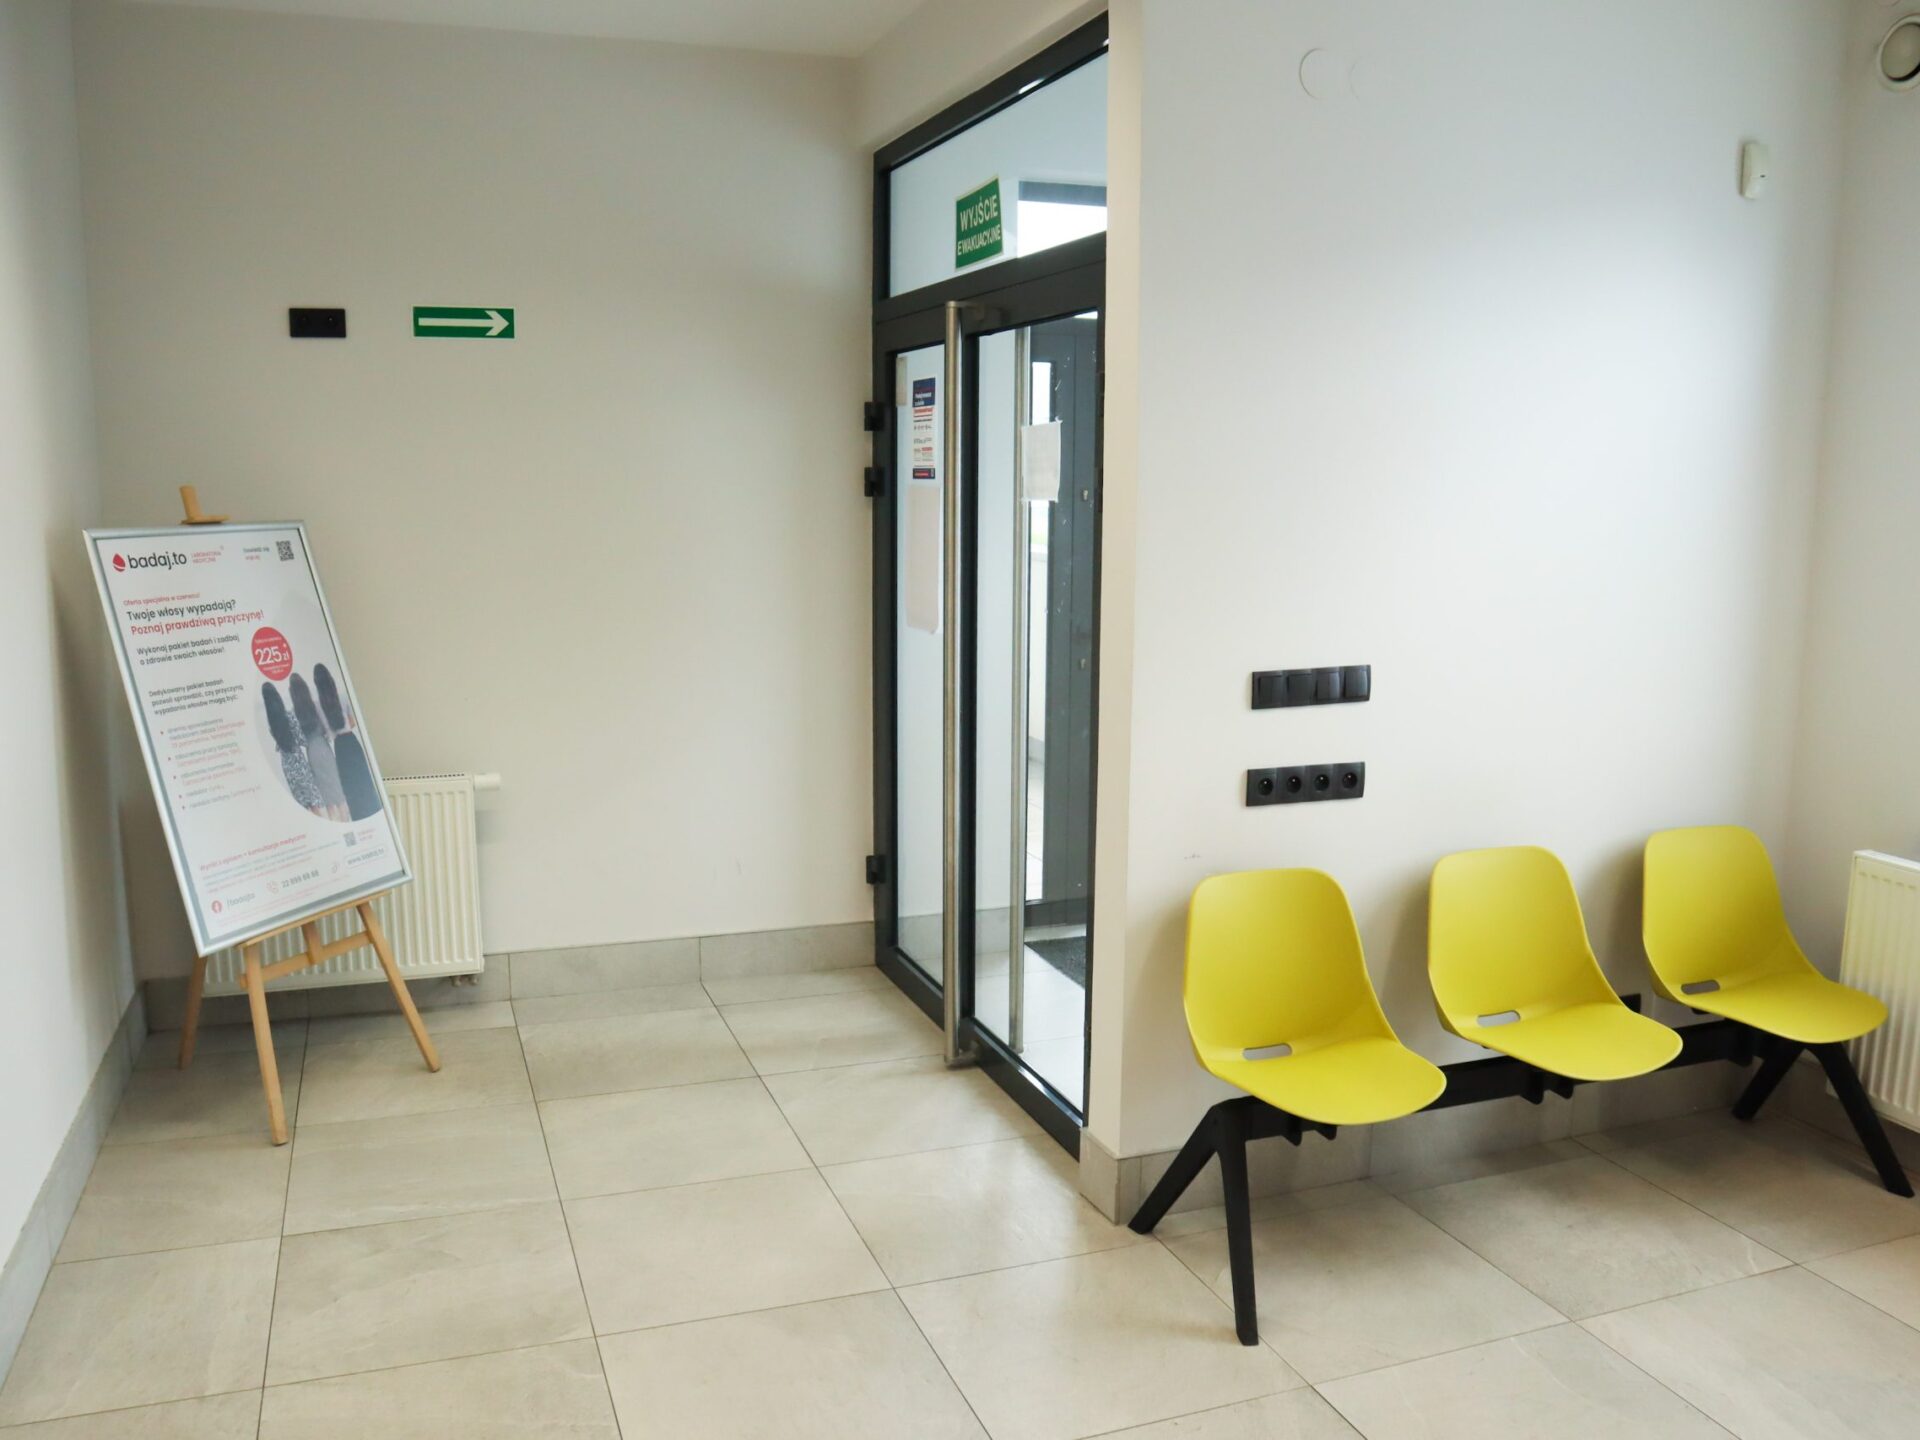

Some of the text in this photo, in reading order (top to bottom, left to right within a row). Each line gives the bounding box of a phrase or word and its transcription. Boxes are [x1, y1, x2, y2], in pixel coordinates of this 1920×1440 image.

[960, 194, 998, 232] WYJŚCIE
[957, 224, 1001, 256] EWAKUACYJNE
[128, 551, 187, 570] badaj.to
[126, 600, 236, 622] Twoje włosy wypadają?
[131, 609, 265, 635] Poznaj prawdziwą przyczynę!
[137, 645, 168, 656] Wykonaj
[168, 641, 190, 652] pakiet
[190, 637, 213, 647] badań
[217, 633, 240, 643] zadbaj
[255, 646, 282, 665] 225
[146, 655, 172, 664] zdrowie
[174, 650, 197, 660] swoich
